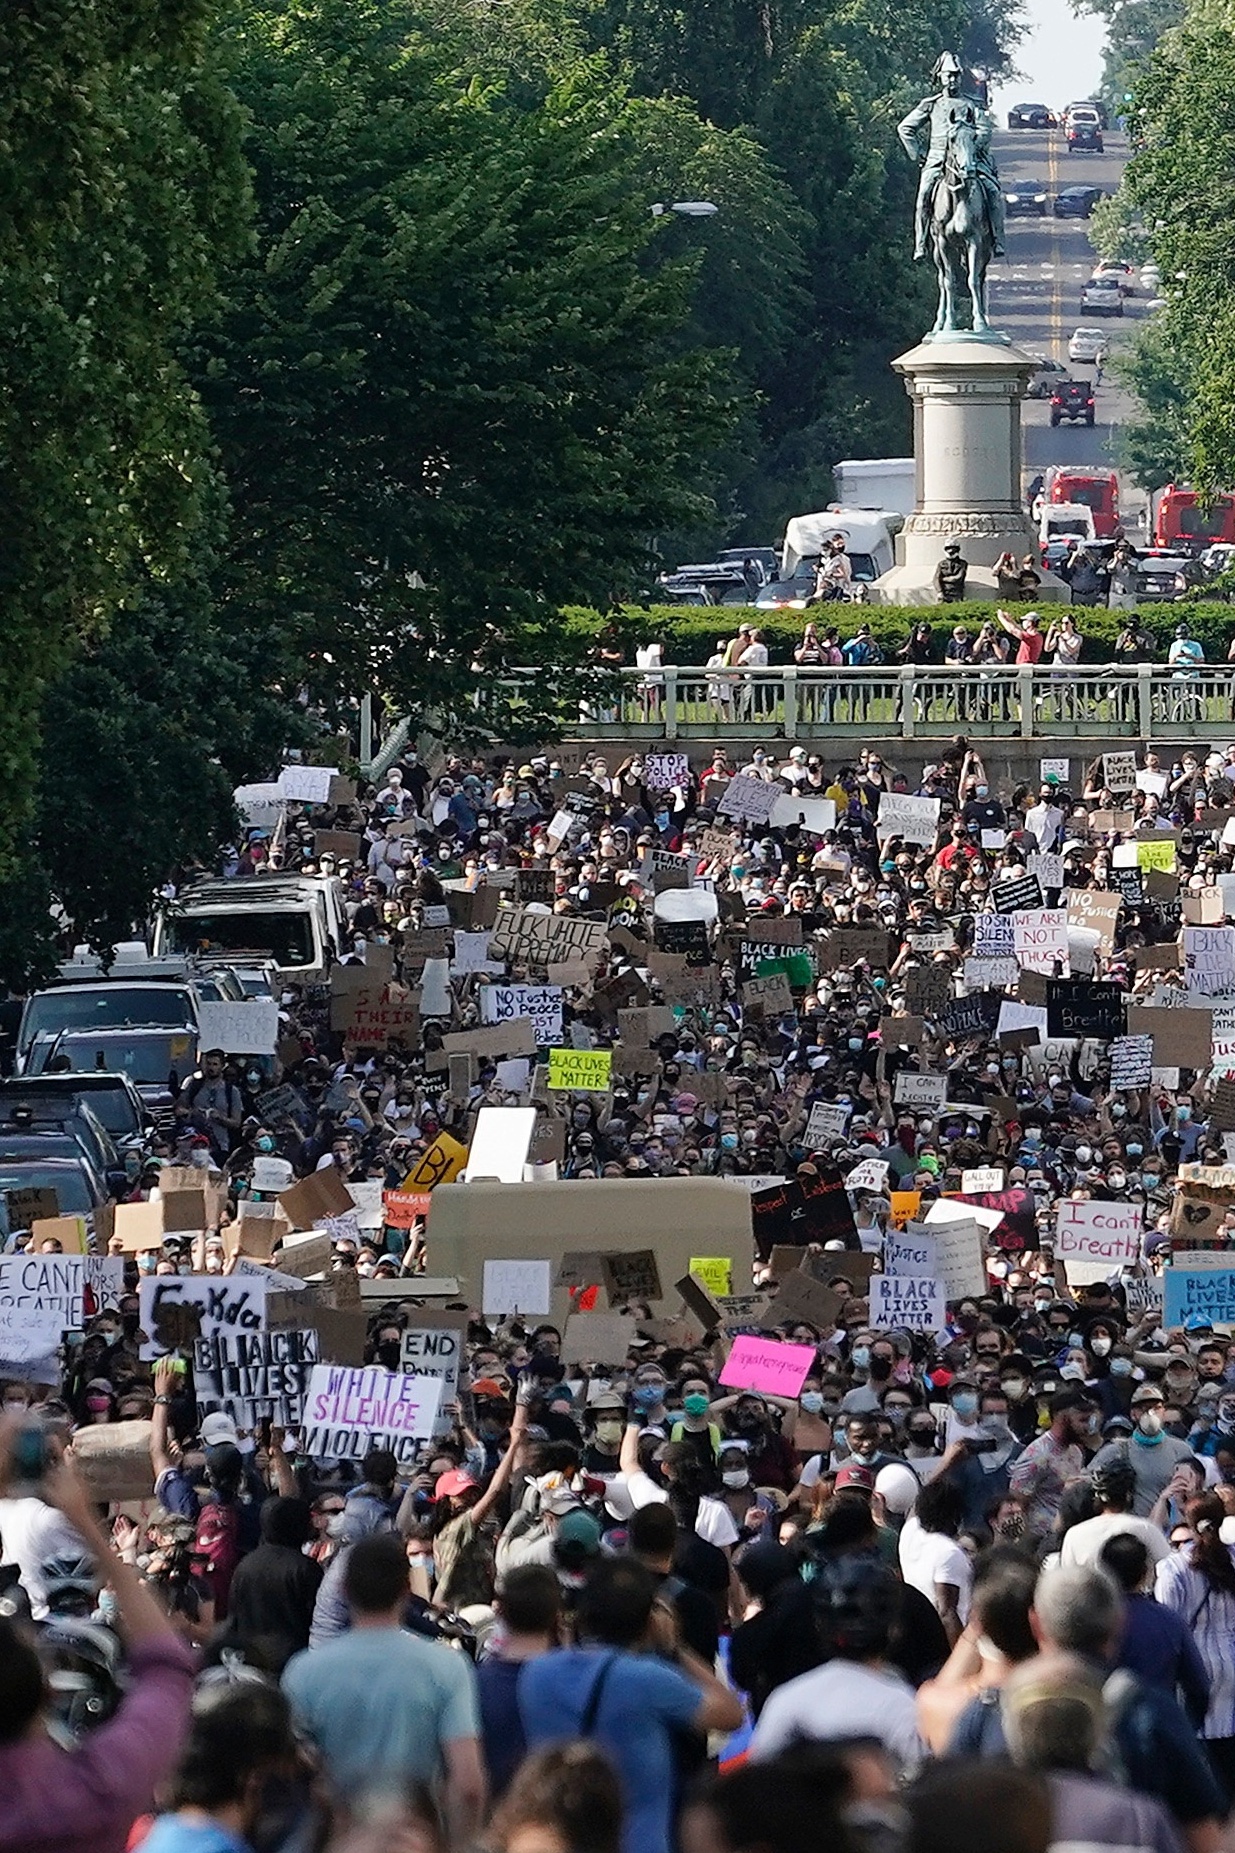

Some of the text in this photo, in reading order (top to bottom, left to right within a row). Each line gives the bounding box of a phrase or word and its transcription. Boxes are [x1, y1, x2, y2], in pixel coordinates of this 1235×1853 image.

[648, 755, 684, 766] STOP
[652, 851, 691, 868] BLACK
[1071, 892, 1092, 908] NO
[1015, 913, 1064, 926] WE ARE
[1069, 915, 1086, 926] NO
[1081, 906, 1117, 919] JUSTICE
[496, 911, 543, 938] FUCK
[979, 916, 993, 927] TO
[1023, 929, 1060, 945] NOT
[741, 942, 776, 957] BLACK
[1016, 950, 1067, 968] THUGS
[496, 990, 514, 1003] NO
[354, 1007, 415, 1024] THEIR
[496, 1003, 514, 1017] NO
[550, 1056, 611, 1072] BLACK LIVES
[560, 1071, 603, 1087] MATTER
[986, 1171, 1000, 1182] OUT
[1064, 1202, 1141, 1229] I can't
[1061, 1230, 1139, 1257] Breath
[0, 1262, 13, 1291] E
[879, 1281, 937, 1299] BLACK
[883, 1300, 928, 1312] LIVES
[1187, 1292, 1235, 1305] LIVES
[876, 1313, 933, 1325] MATTER
[195, 1329, 317, 1372] BLACK
[405, 1334, 456, 1356] END
[222, 1364, 301, 1398] LIVES
[327, 1368, 416, 1402] WHITE
[312, 1394, 420, 1431] SILENCE
[300, 1426, 429, 1465] VIOLENCE
